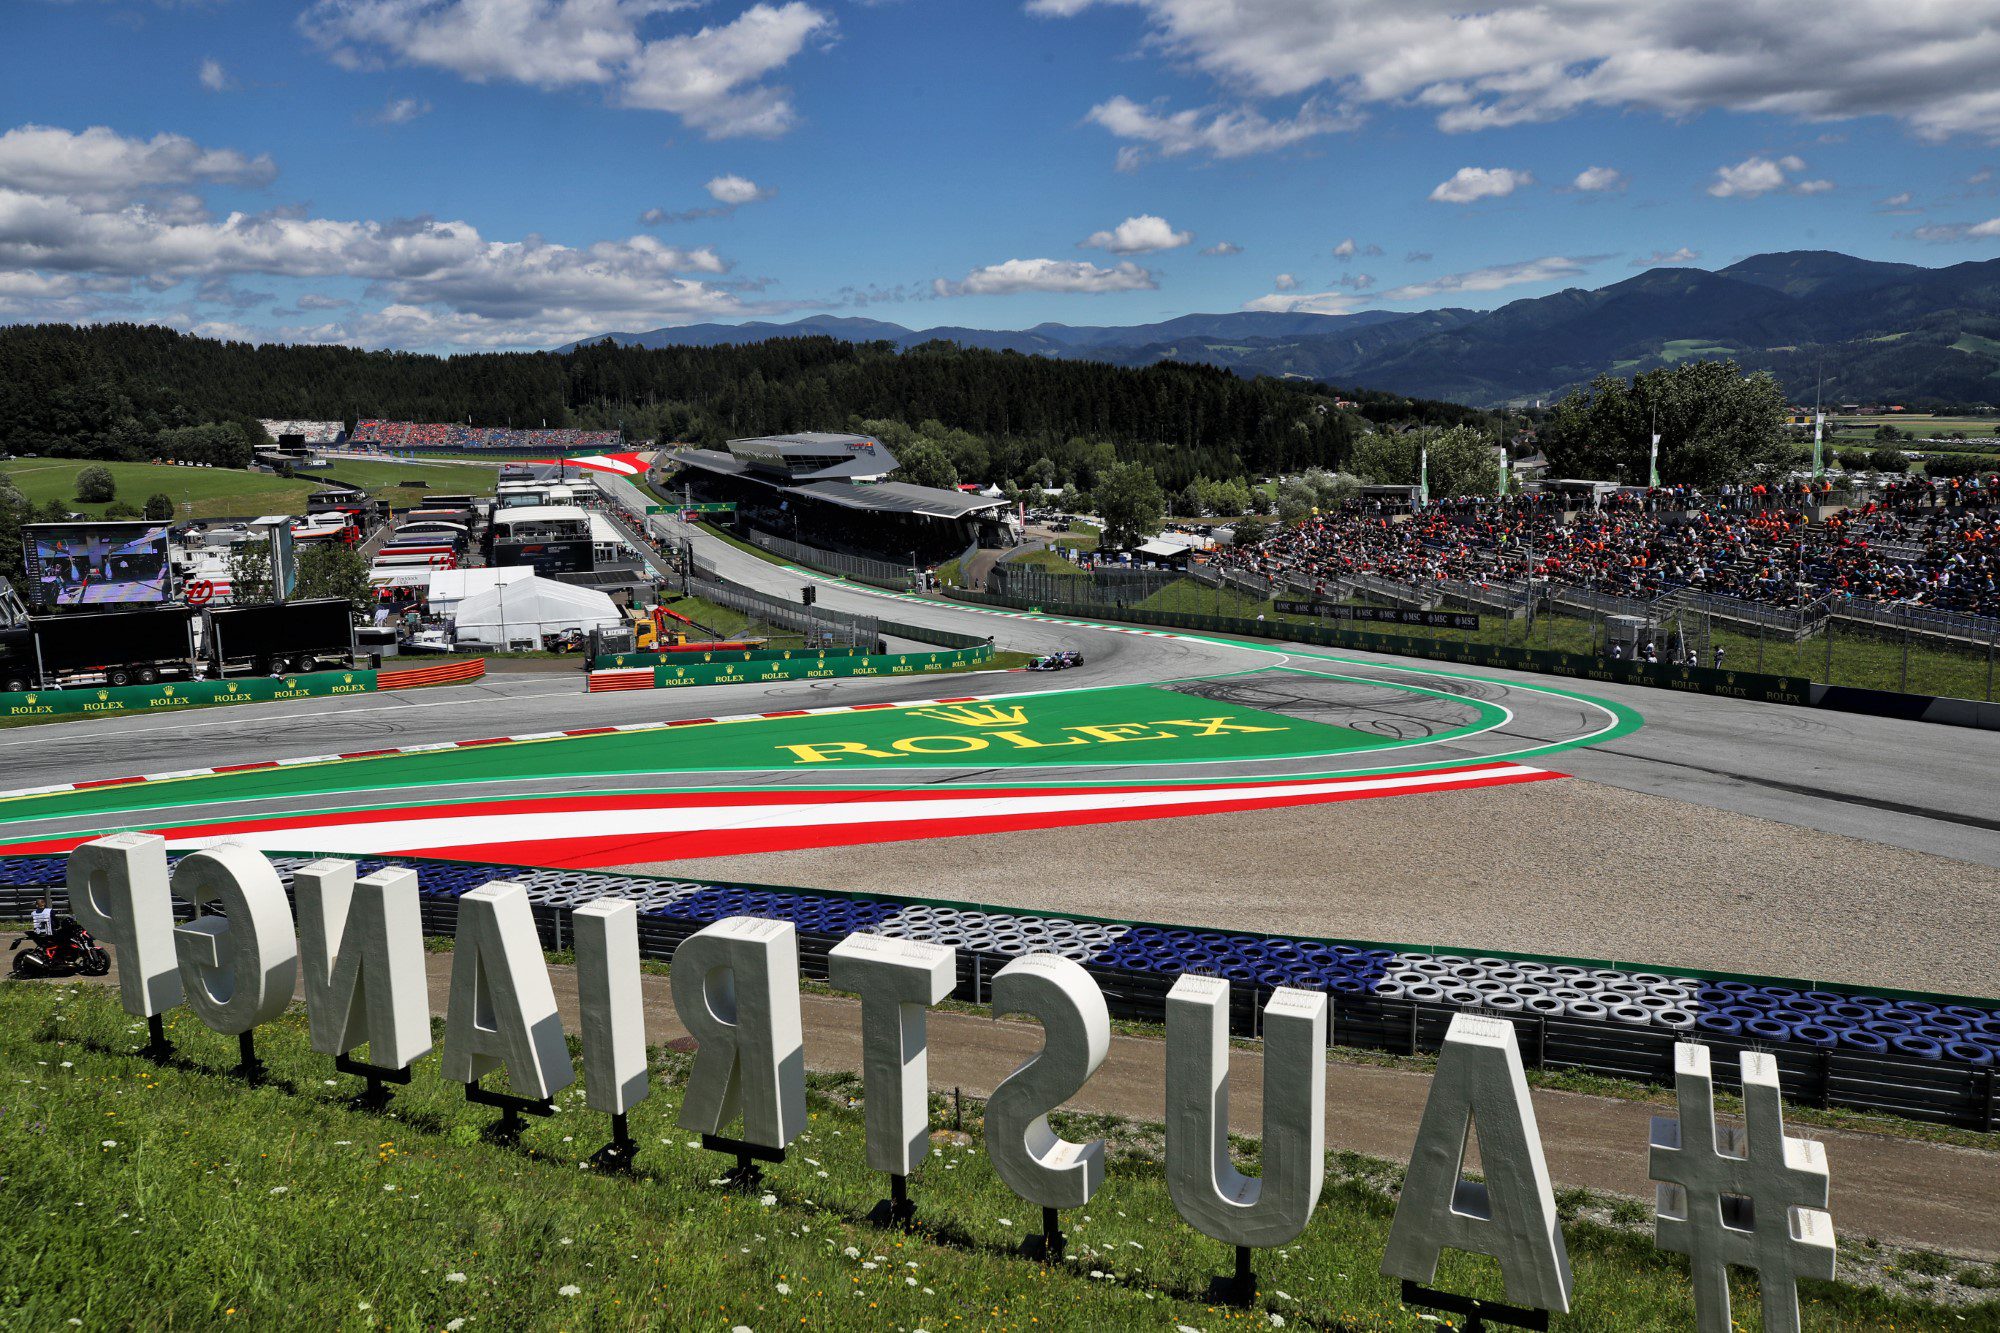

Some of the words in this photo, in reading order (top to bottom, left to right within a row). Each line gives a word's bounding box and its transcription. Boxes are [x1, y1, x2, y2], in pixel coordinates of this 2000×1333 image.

[1384, 611, 1396, 619] MSC
[1409, 612, 1421, 621] MSC
[1434, 614, 1447, 623] MSC
[1461, 616, 1475, 626] MSC
[807, 669, 834, 677] ROLEX
[853, 667, 877, 675] ROLEX
[892, 665, 914, 673] ROLEX
[1553, 665, 1577, 675] ROLEX
[715, 674, 744, 682] ROLEX
[761, 672, 789, 680] ROLEX
[1588, 670, 1614, 680] ROLEX
[665, 677, 695, 686] ROLEX
[1627, 674, 1656, 686] ROLEX
[332, 684, 366, 693] ROLEX
[1671, 679, 1700, 692] ROLEX
[274, 688, 310, 698] ROLEX
[1715, 684, 1746, 697] ROLEX
[150, 696, 189, 706] ROLEX
[214, 693, 252, 702] ROLEX
[1766, 690, 1800, 704] ROLEX
[11, 705, 53, 714] ROLEX
[83, 701, 124, 711] ROLEX
[775, 716, 1291, 764] ROLEX
